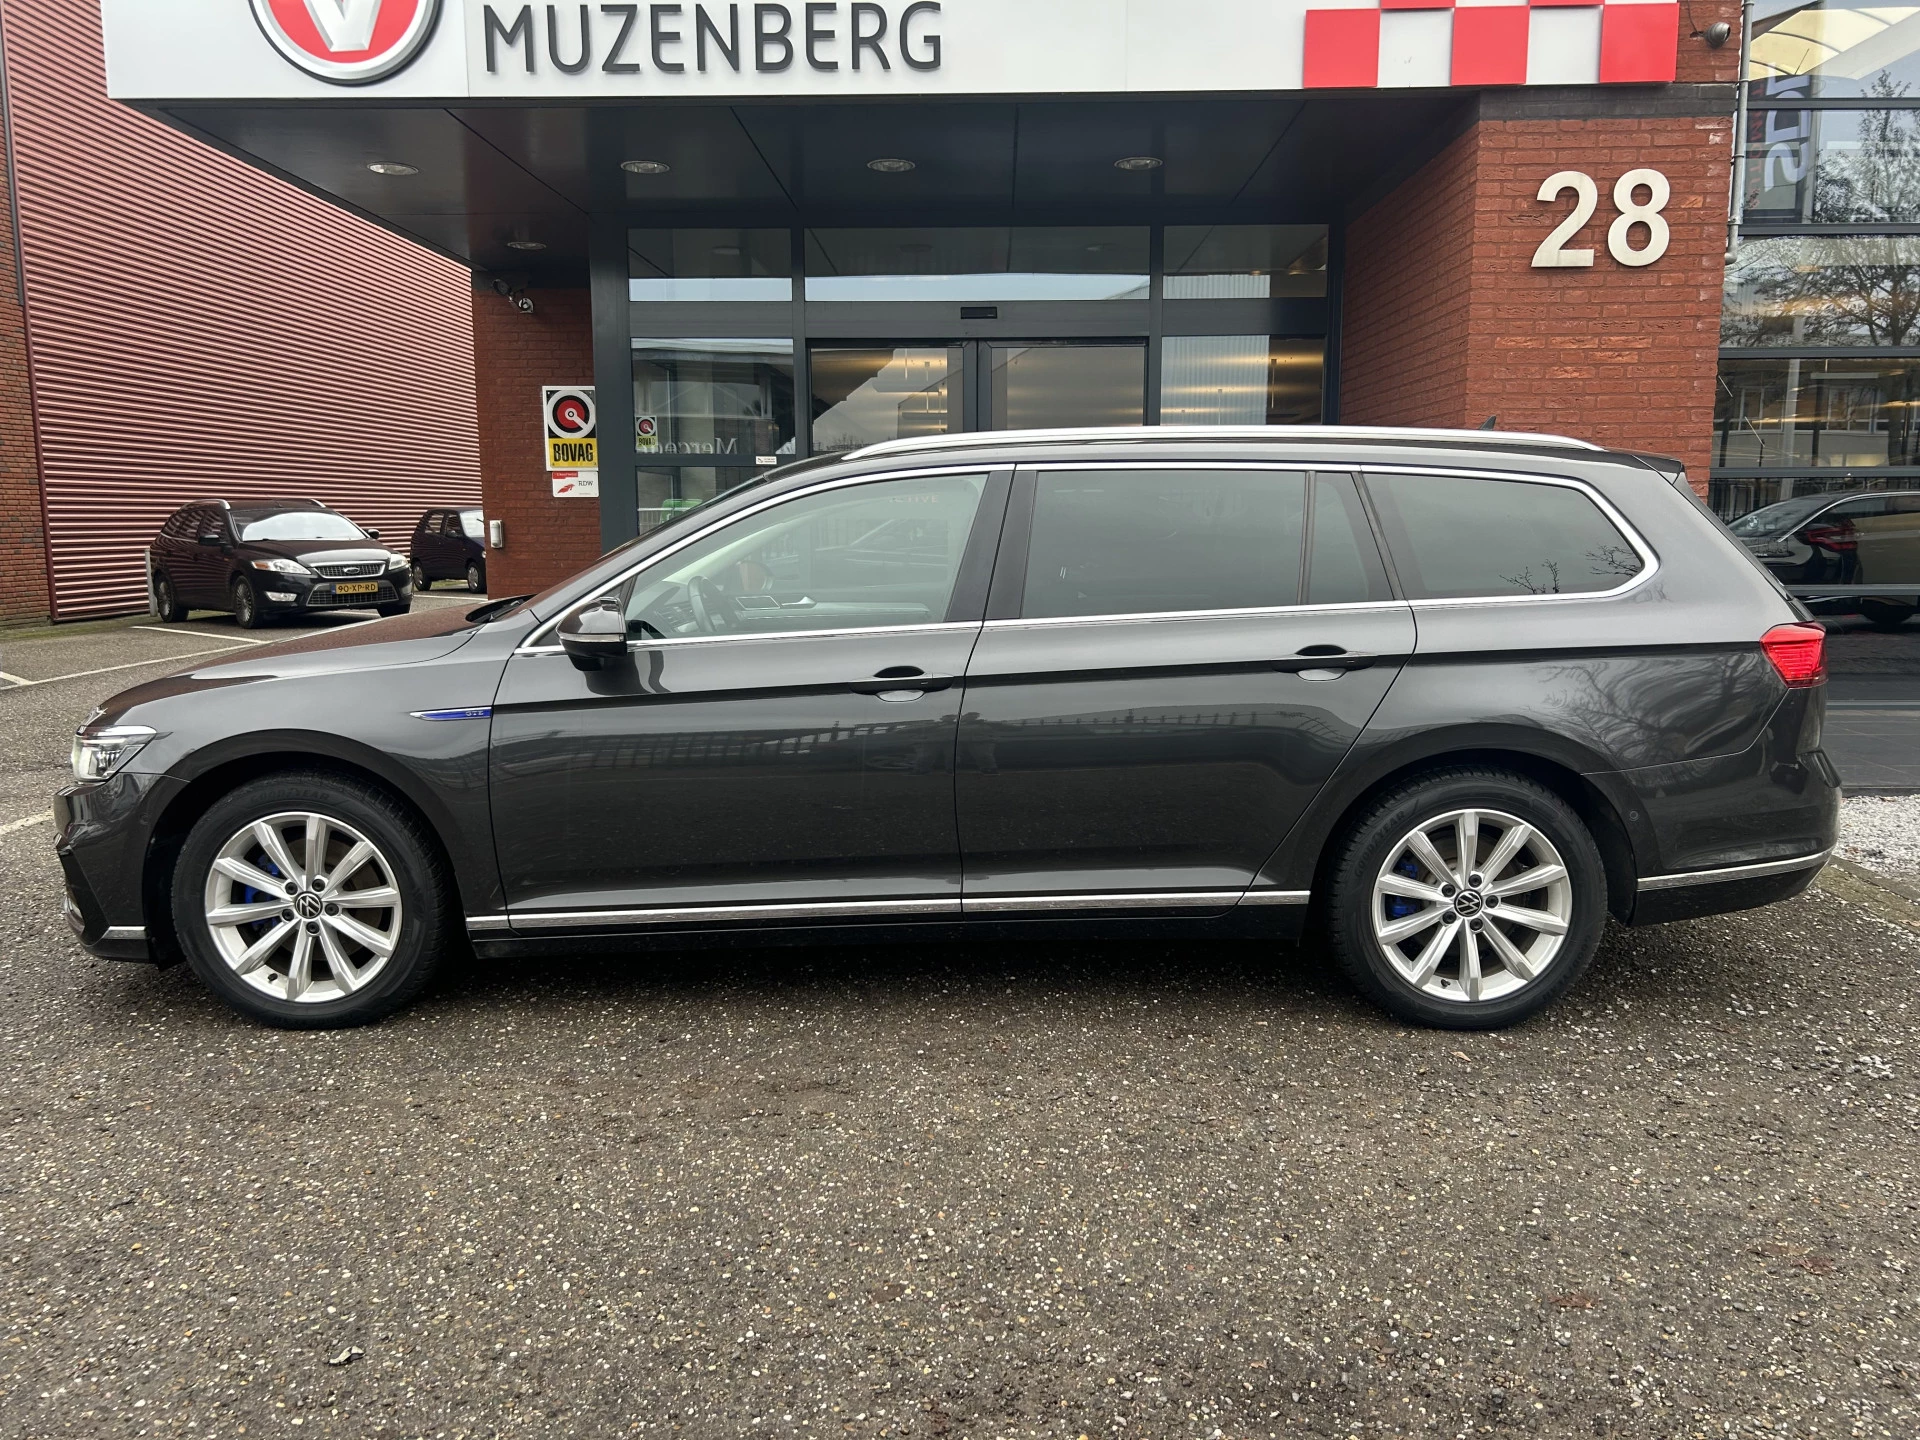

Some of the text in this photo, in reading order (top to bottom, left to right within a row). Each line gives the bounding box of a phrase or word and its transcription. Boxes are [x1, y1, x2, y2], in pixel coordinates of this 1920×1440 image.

[484, 1, 942, 74] MUZENBERG
[1531, 168, 1670, 268] 28
[553, 443, 594, 462] BOVAG
